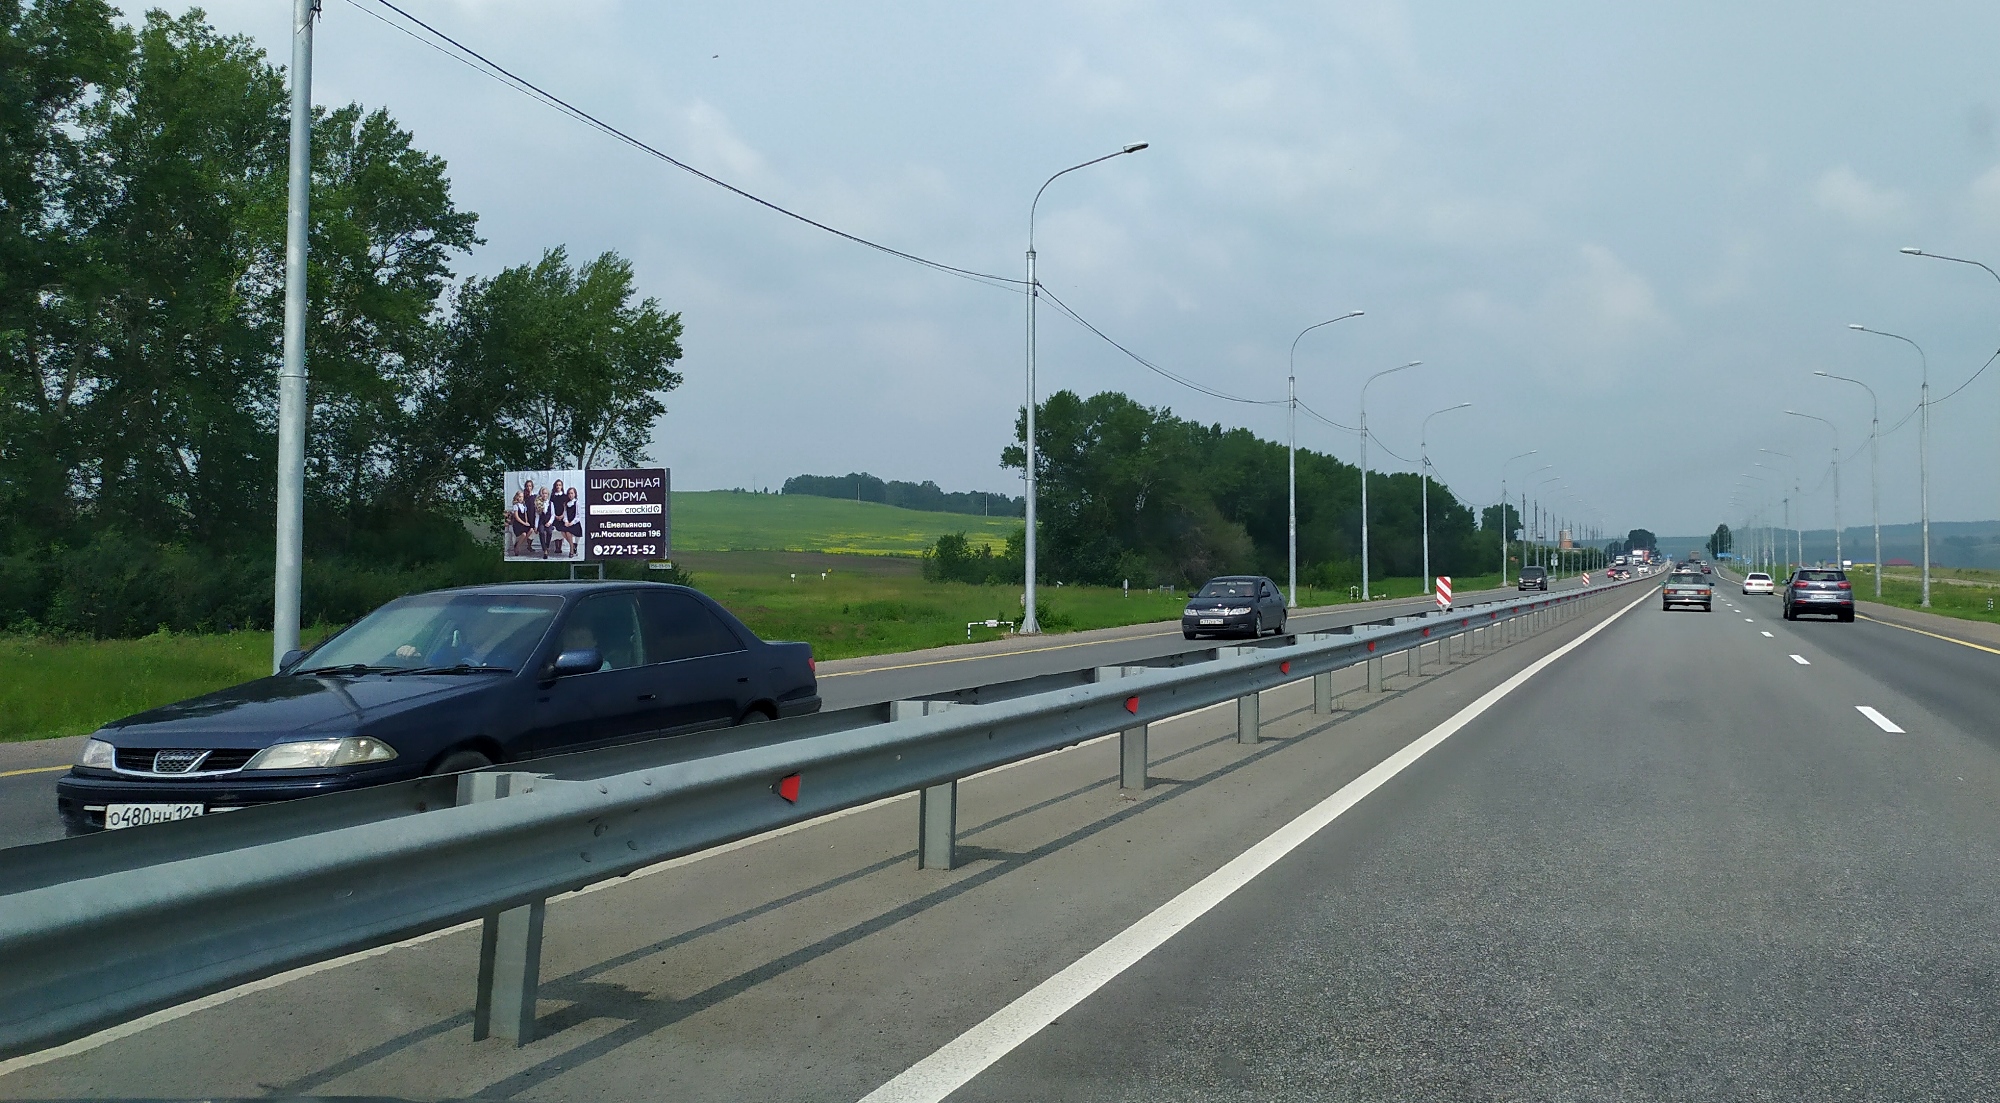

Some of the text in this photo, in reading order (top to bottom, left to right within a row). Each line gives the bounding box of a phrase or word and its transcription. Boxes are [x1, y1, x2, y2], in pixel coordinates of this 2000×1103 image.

[590, 477, 660, 489] ШКОЛЬНАЯ
[603, 492, 648, 502] ФОРМА
[590, 529, 661, 539] ул.Московская 196
[603, 544, 656, 555] 272-13-52
